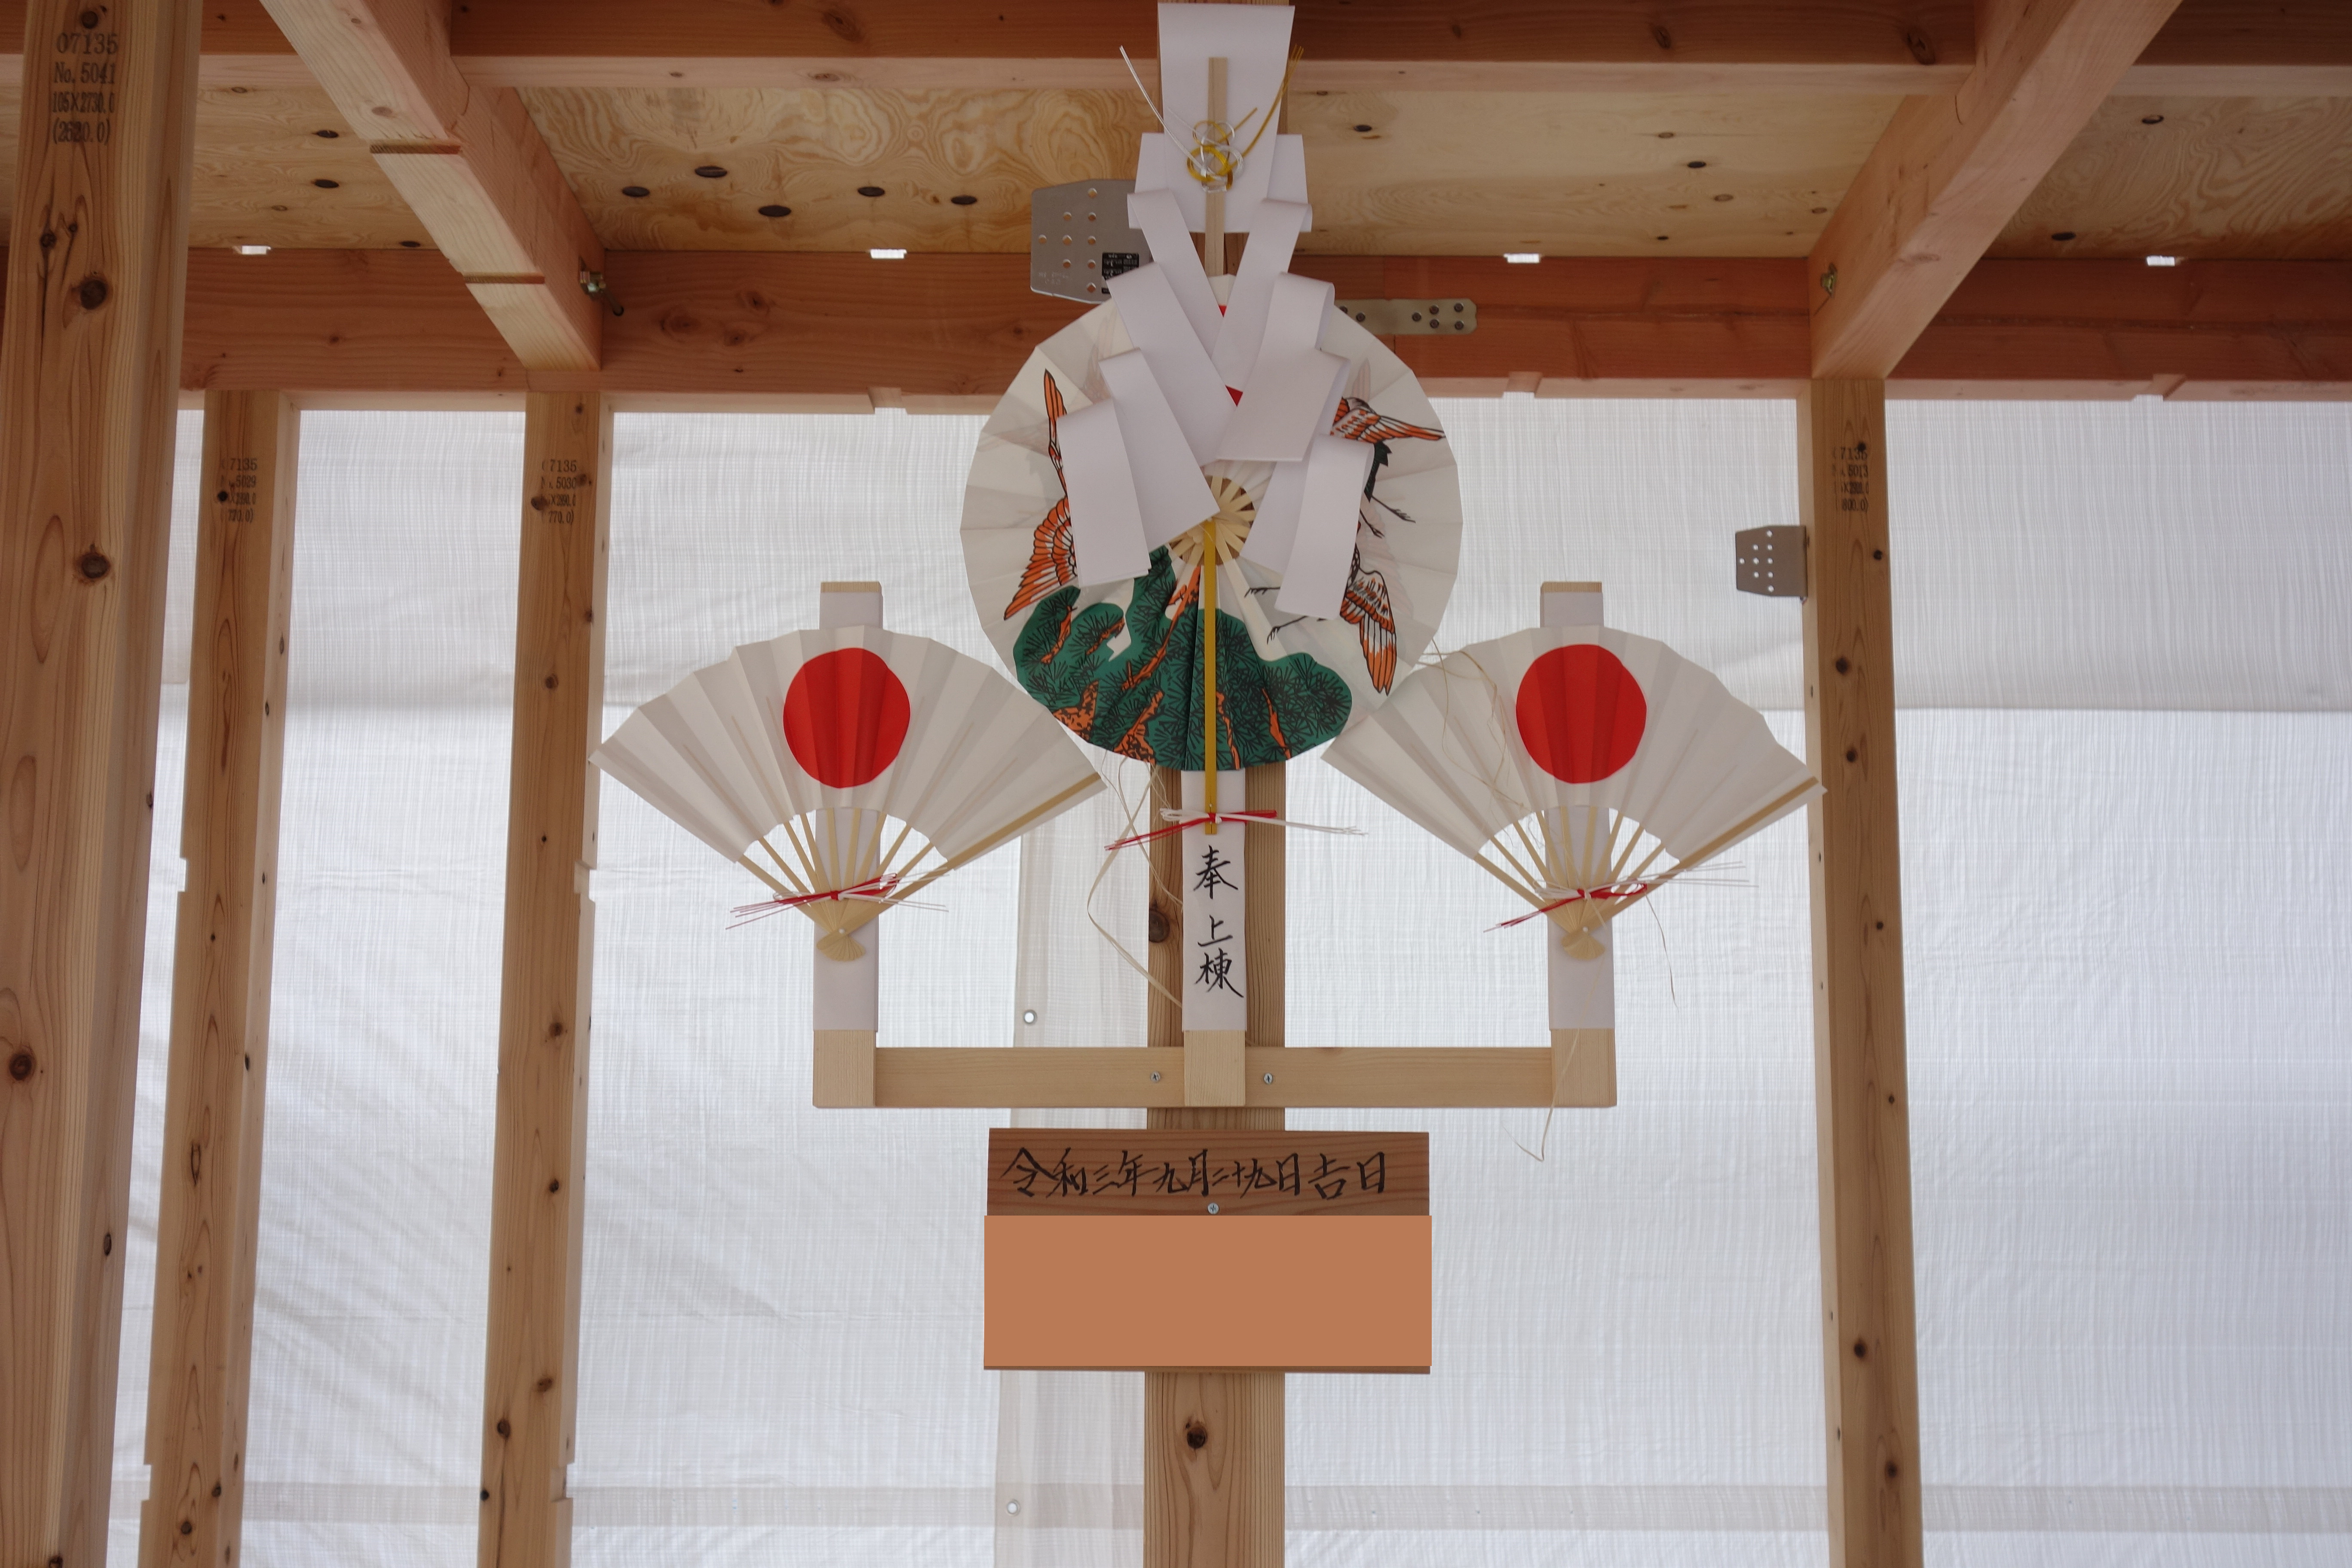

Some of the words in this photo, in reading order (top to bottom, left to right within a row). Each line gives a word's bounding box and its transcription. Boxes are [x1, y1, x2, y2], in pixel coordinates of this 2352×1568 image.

[57, 32, 118, 55] 07135
[54, 62, 76, 84] No.
[80, 62, 116, 84] 5041
[1193, 844, 1244, 998] 奉上棟
[999, 1147, 1385, 1200] 令和三年九月二十九日吉日
